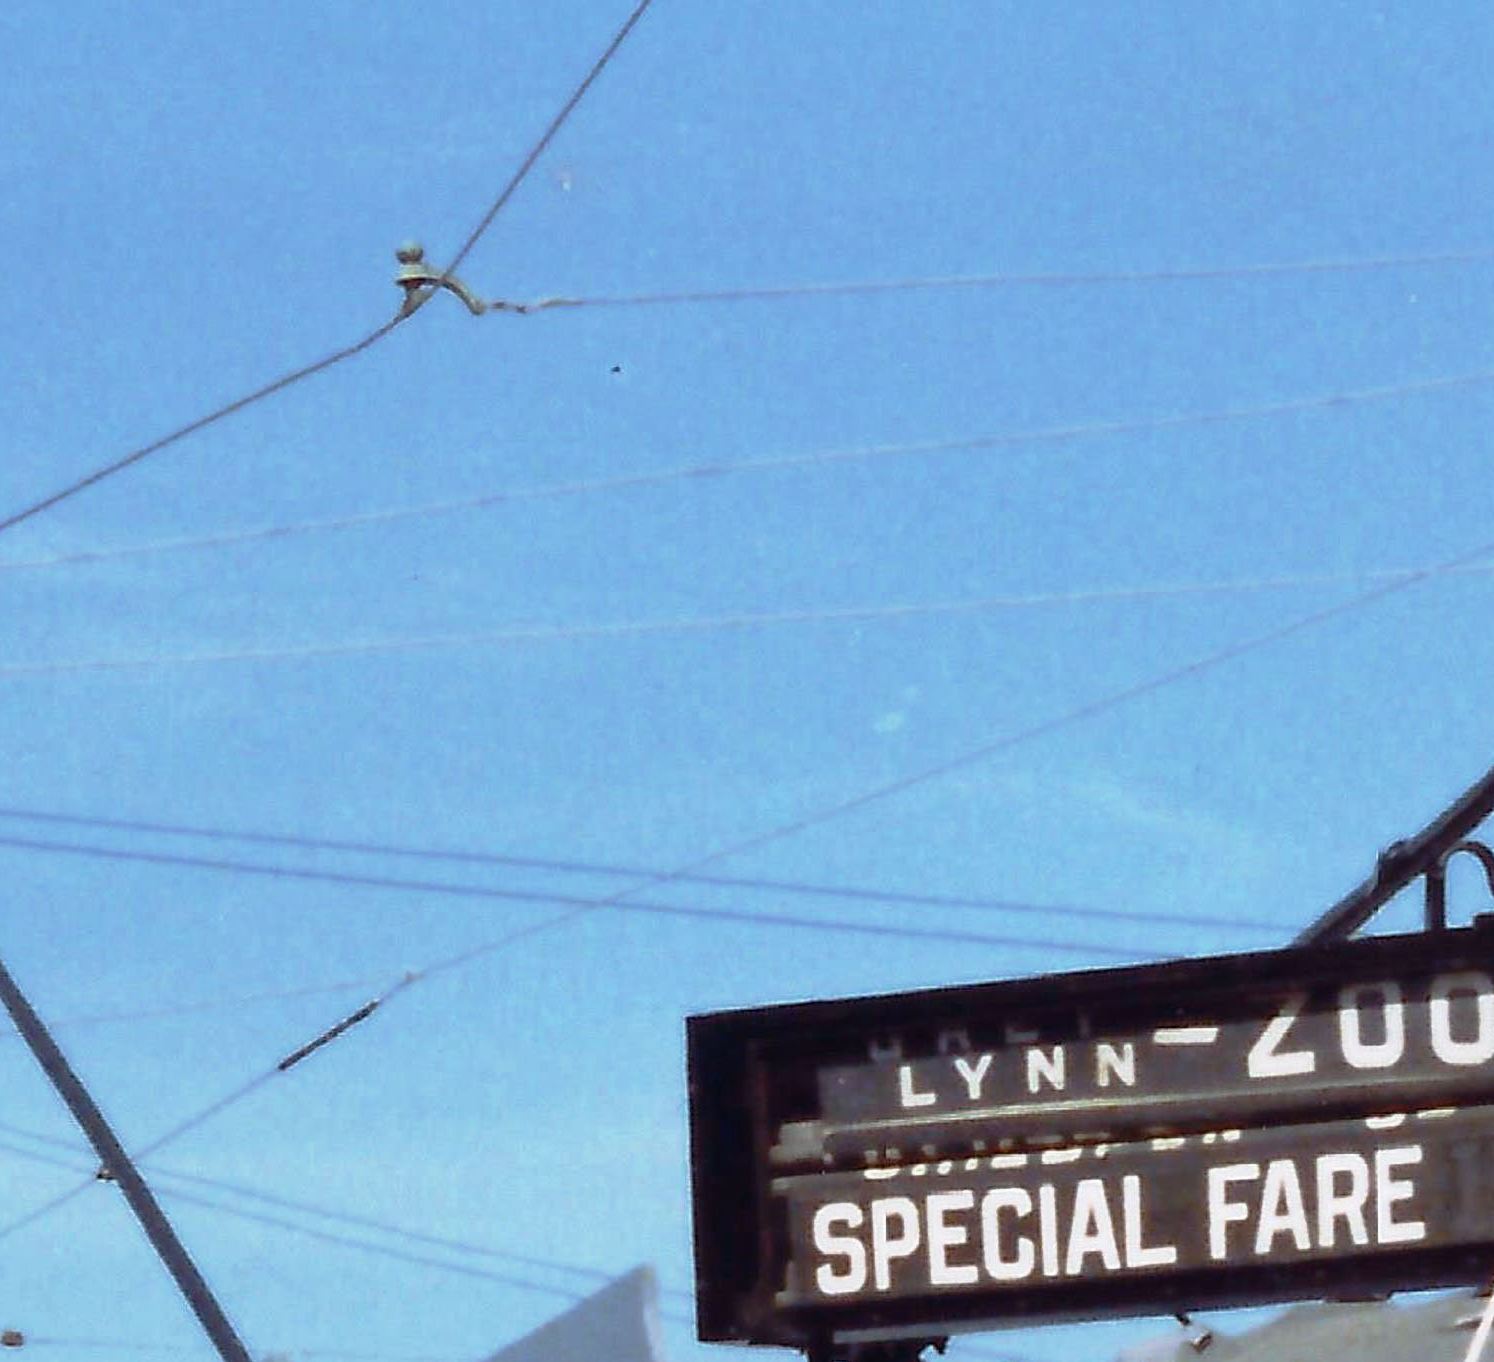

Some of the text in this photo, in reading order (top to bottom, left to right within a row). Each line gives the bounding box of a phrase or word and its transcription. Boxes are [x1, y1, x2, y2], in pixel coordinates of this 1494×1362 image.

[898, 1041, 1137, 1108] LYNN
[813, 1145, 1426, 1296] SPECIAL FARE
